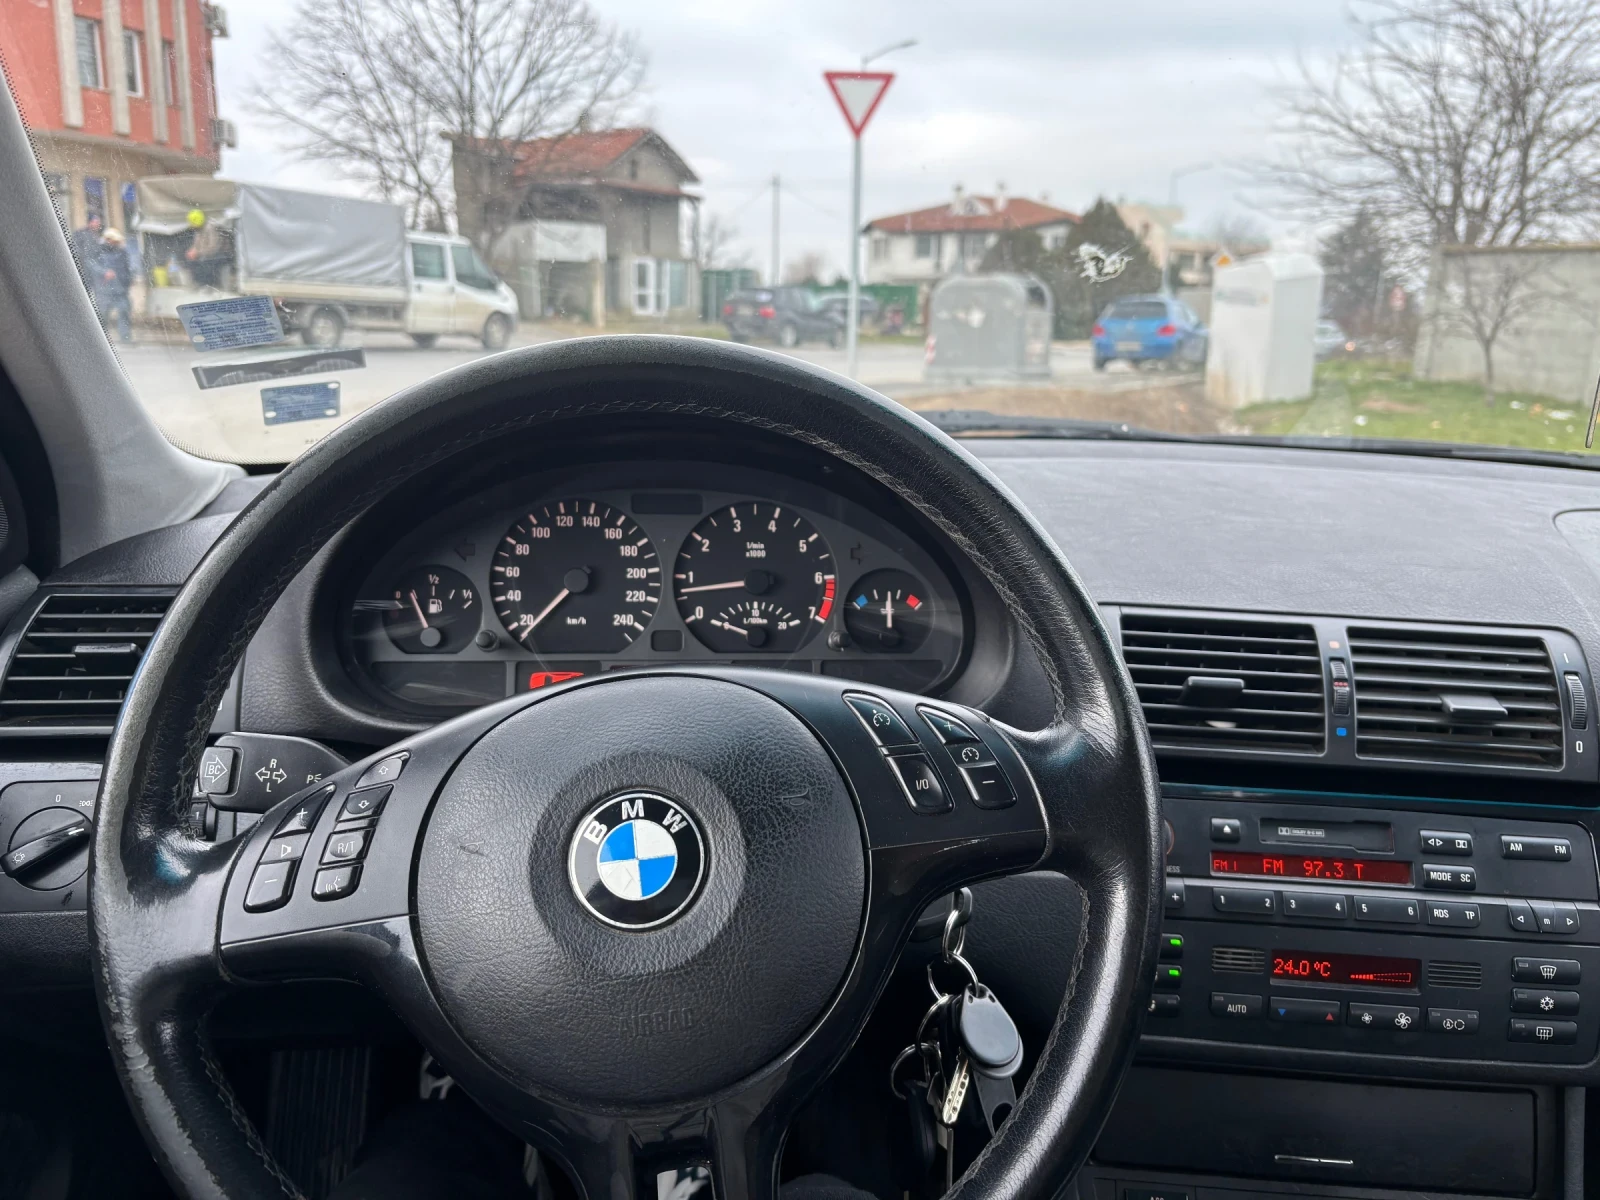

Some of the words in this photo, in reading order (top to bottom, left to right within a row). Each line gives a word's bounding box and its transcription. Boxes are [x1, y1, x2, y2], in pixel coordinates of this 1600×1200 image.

[556, 516, 573, 527] 120
[582, 516, 600, 527] 140
[733, 520, 741, 532] 3
[768, 520, 777, 532] 4
[532, 527, 550, 538] 100
[604, 528, 622, 539] 160
[515, 544, 530, 555] 80
[620, 545, 638, 557] 180
[702, 539, 710, 552] 2
[799, 540, 807, 552] 5
[506, 567, 520, 577] 60
[626, 568, 646, 579] 200
[688, 571, 694, 583] 1
[814, 572, 823, 584] 6
[395, 590, 401, 599] 0
[507, 590, 521, 601] 40
[626, 591, 646, 602] 220
[695, 606, 704, 619] 0
[751, 609, 760, 617] 10
[808, 607, 816, 619] 7
[520, 614, 534, 625] 20
[566, 617, 587, 625] km/h
[613, 614, 633, 626] 240
[777, 621, 787, 630] 20
[270, 759, 277, 768] R
[208, 765, 221, 775] BC
[266, 782, 272, 792] L
[583, 799, 689, 846] BMW
[337, 841, 355, 853] R/T
[1510, 843, 1523, 852] AM
[1554, 845, 1567, 854] FM
[1263, 859, 1284, 875] FM
[1303, 860, 1344, 878] 97.3
[1354, 863, 1363, 879] T
[1430, 872, 1452, 882] MODE
[1460, 873, 1471, 883] SC
[1220, 895, 1225, 904] 1
[1265, 898, 1270, 908] 2
[1290, 900, 1296, 909] 3
[1335, 902, 1341, 912] 4
[1362, 904, 1368, 913] 5
[1408, 907, 1414, 916] 6
[1433, 909, 1450, 919] RDS
[1464, 910, 1475, 920] TP
[1273, 958, 1309, 976] 24.0
[1227, 1004, 1247, 1014] AUTO
